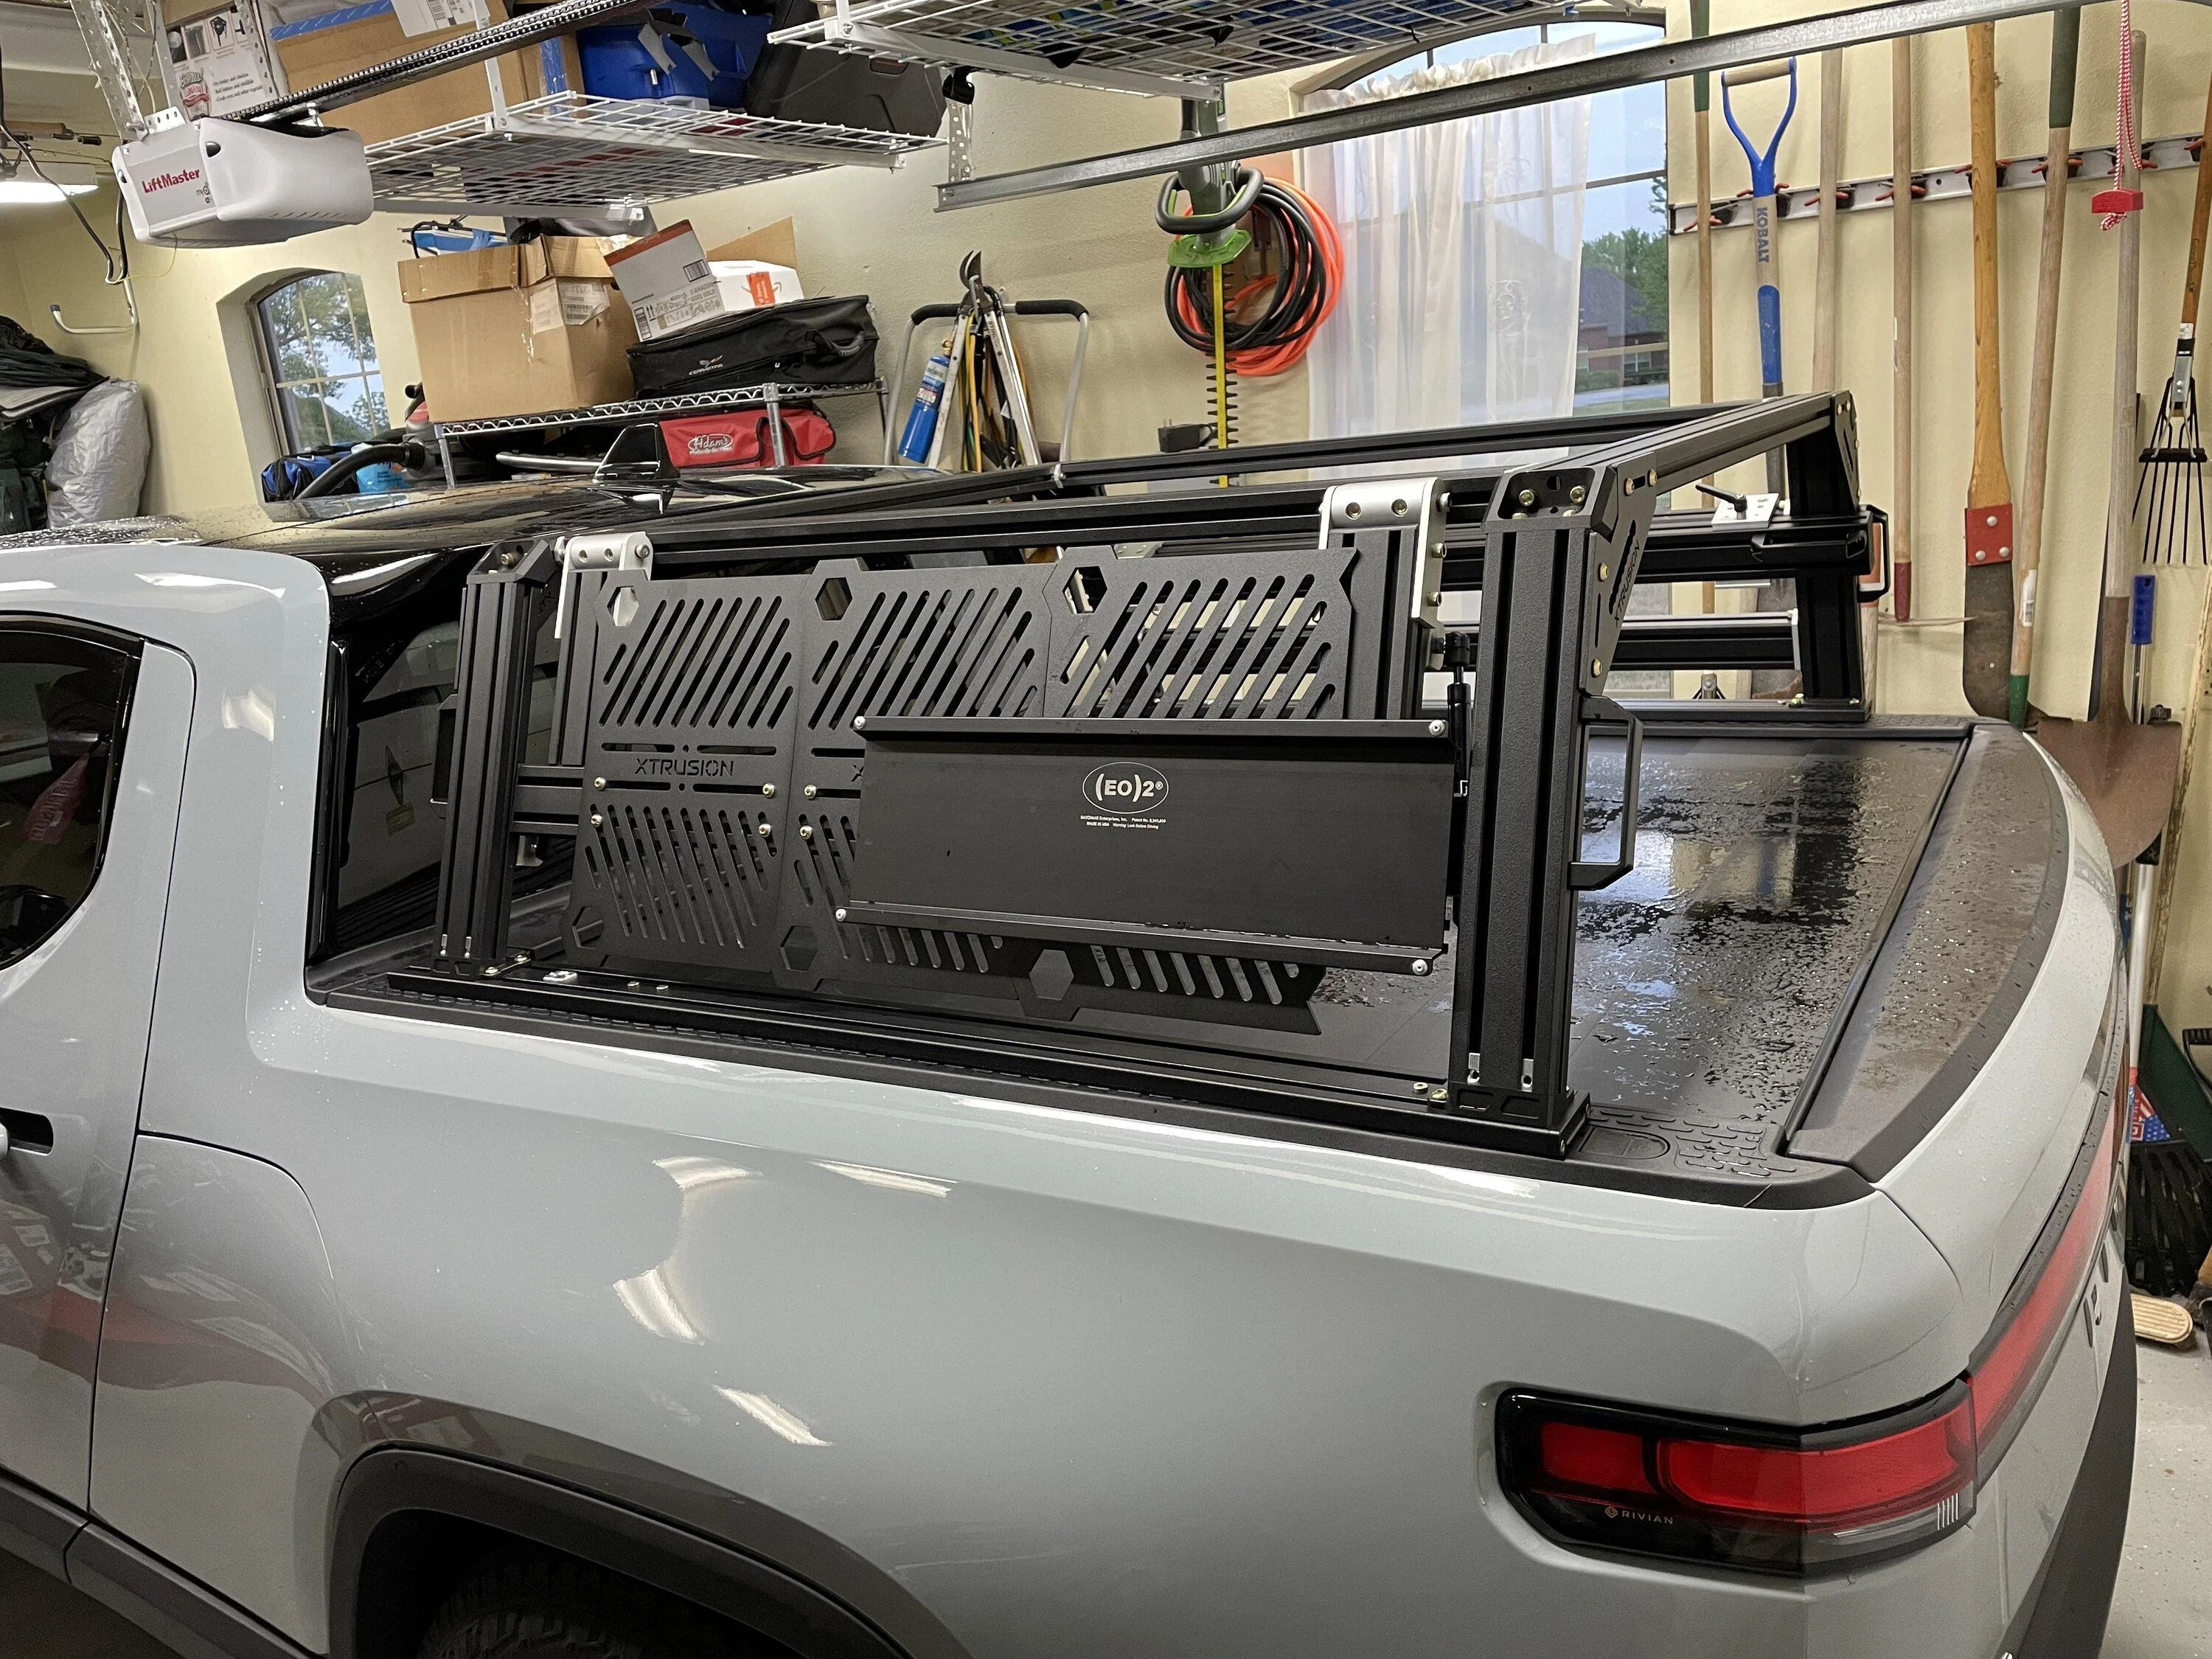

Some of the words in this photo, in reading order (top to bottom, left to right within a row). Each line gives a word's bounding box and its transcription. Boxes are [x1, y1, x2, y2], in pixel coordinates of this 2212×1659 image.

[142, 169, 200, 193] LiftMaster
[1756, 206, 1770, 263] KOBALT
[693, 435, 728, 449] Adam's
[1615, 538, 1640, 629] XTRUSION
[634, 758, 734, 777] XTRUSION
[1621, 1510, 1673, 1525] RIVIAN
